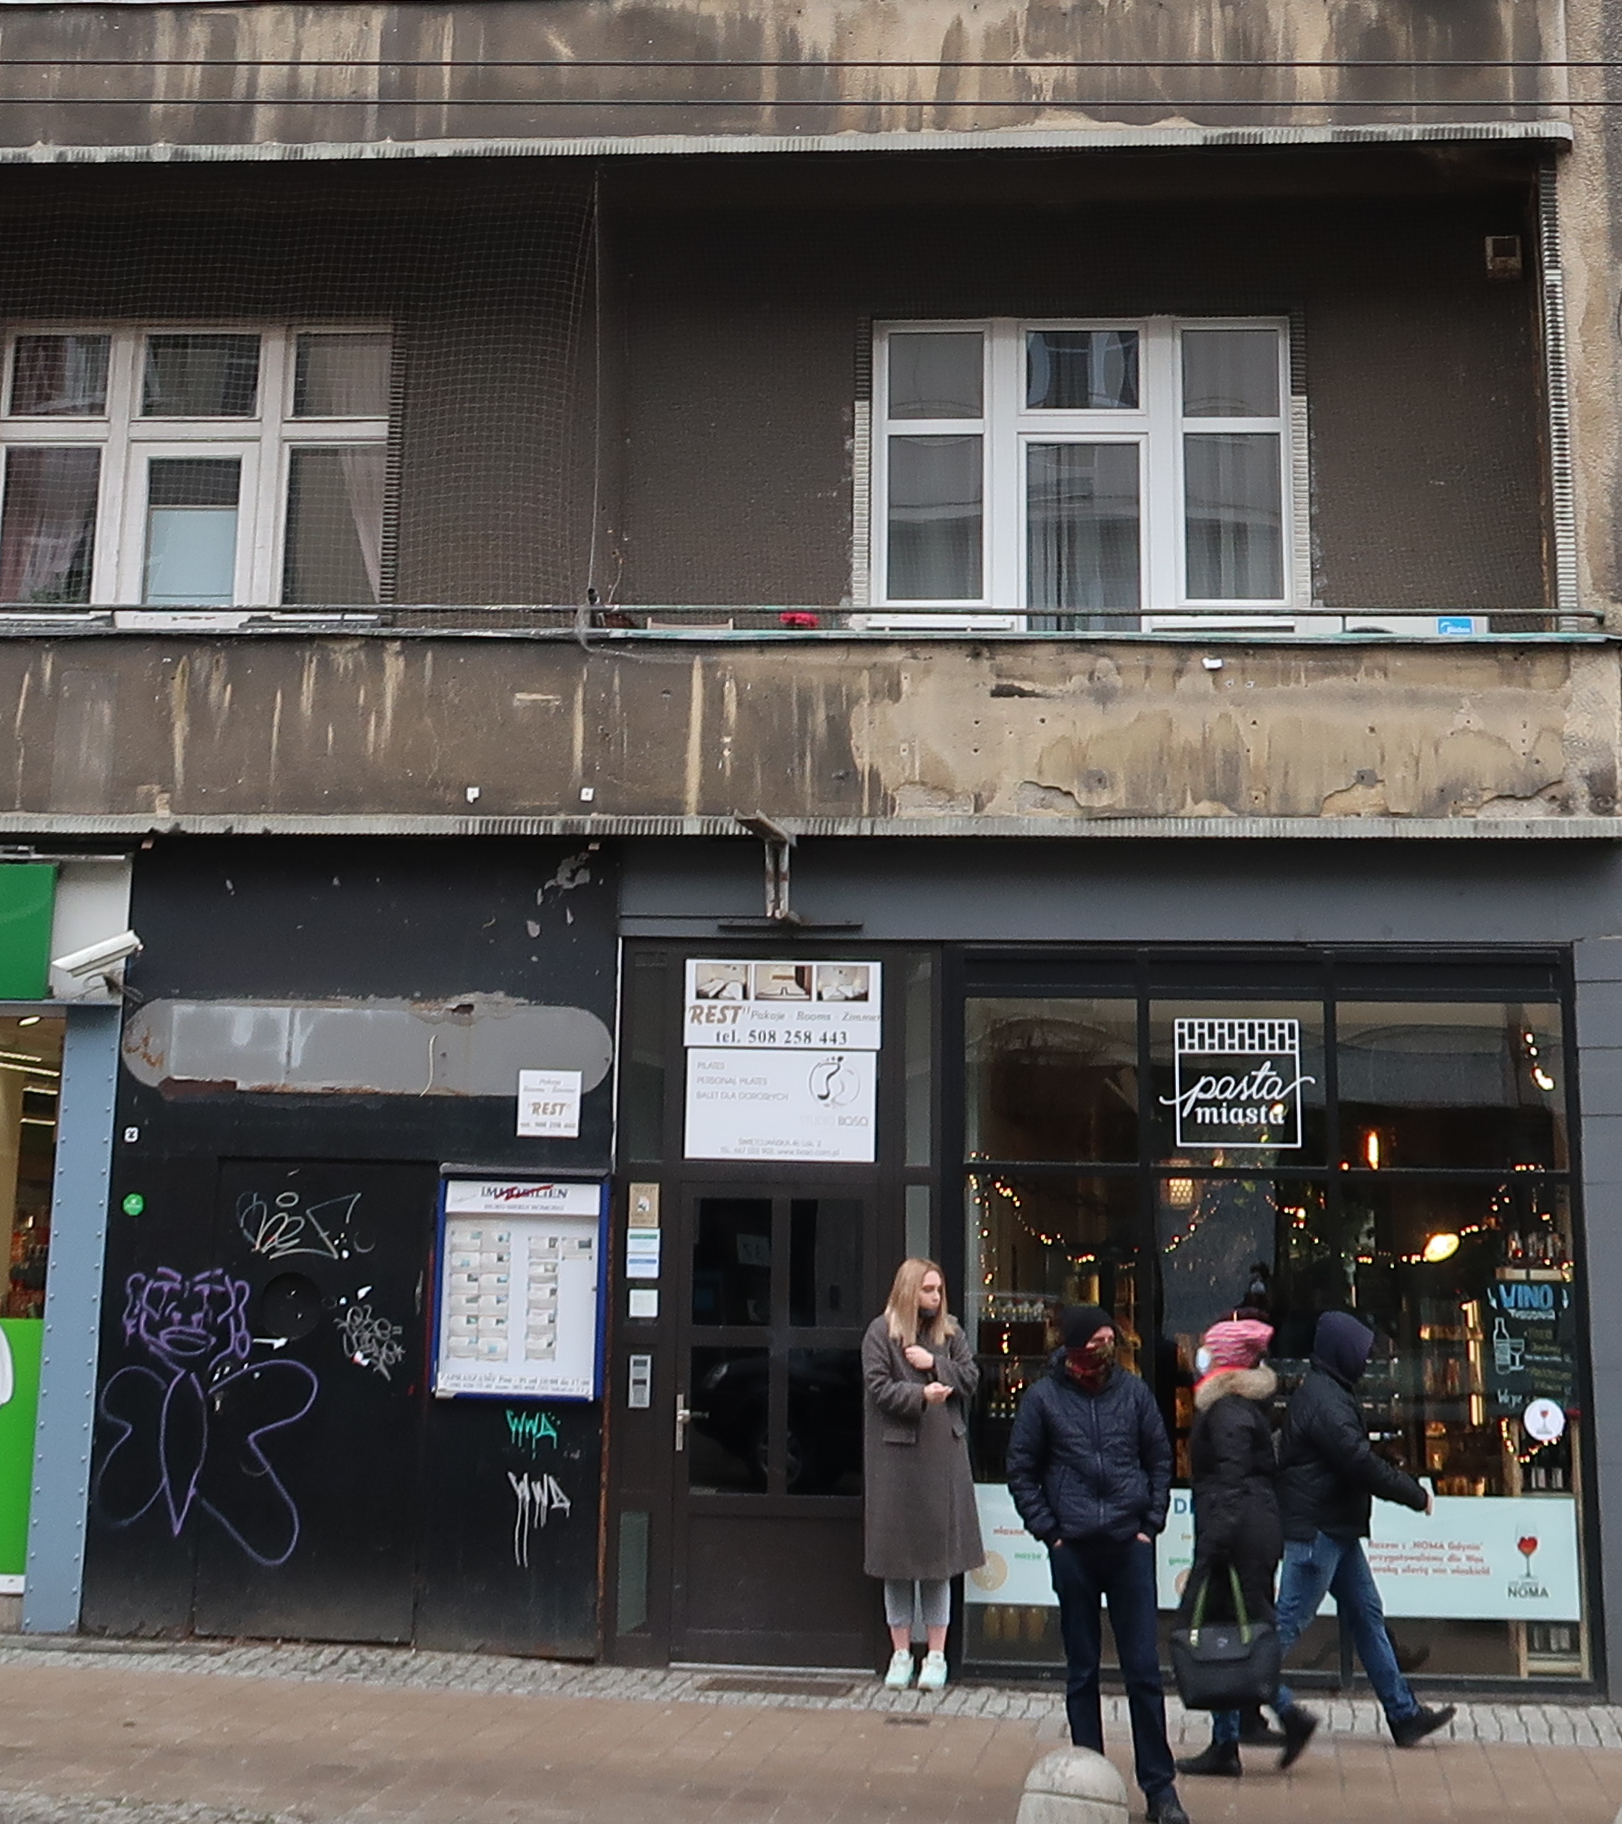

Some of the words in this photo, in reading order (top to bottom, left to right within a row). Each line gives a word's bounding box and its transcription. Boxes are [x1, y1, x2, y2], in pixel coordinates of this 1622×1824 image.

[750, 1010, 786, 1022] Pokoje
[796, 1011, 831, 1021] Rooms
[716, 1030, 741, 1044] tel.
[748, 1030, 777, 1044] 508
[784, 1031, 812, 1044] 258
[819, 1031, 847, 1045] 443
[1159, 1061, 1316, 1118] pasta
[1195, 1102, 1285, 1124] miasta
[1508, 1587, 1549, 1598] NOMA
